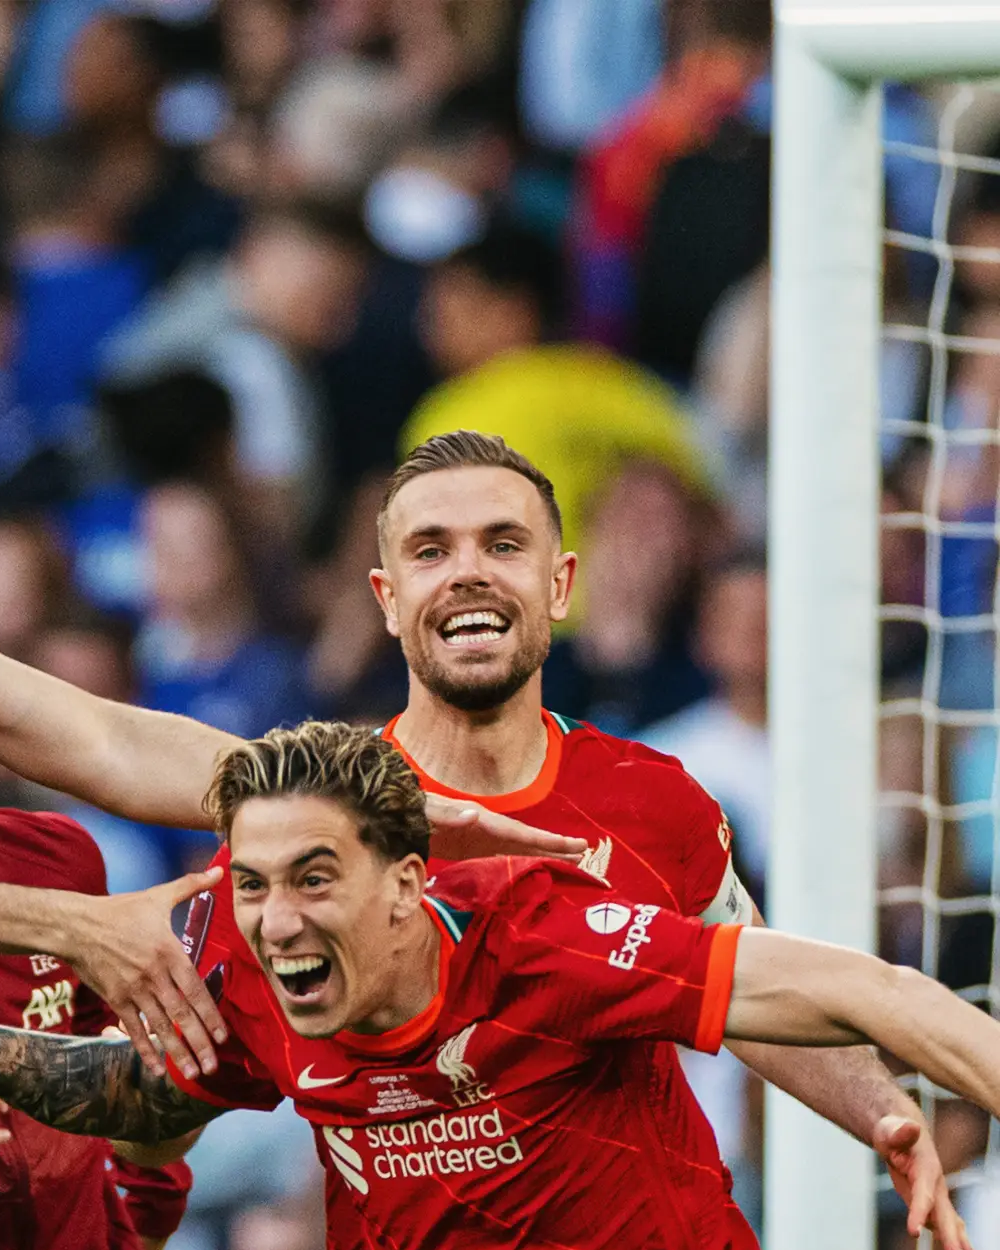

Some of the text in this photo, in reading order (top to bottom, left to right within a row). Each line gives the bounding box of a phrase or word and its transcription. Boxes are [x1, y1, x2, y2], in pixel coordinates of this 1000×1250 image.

[608, 903, 661, 970] Exped
[365, 1108, 504, 1148] standard
[373, 1136, 523, 1179] chartered
